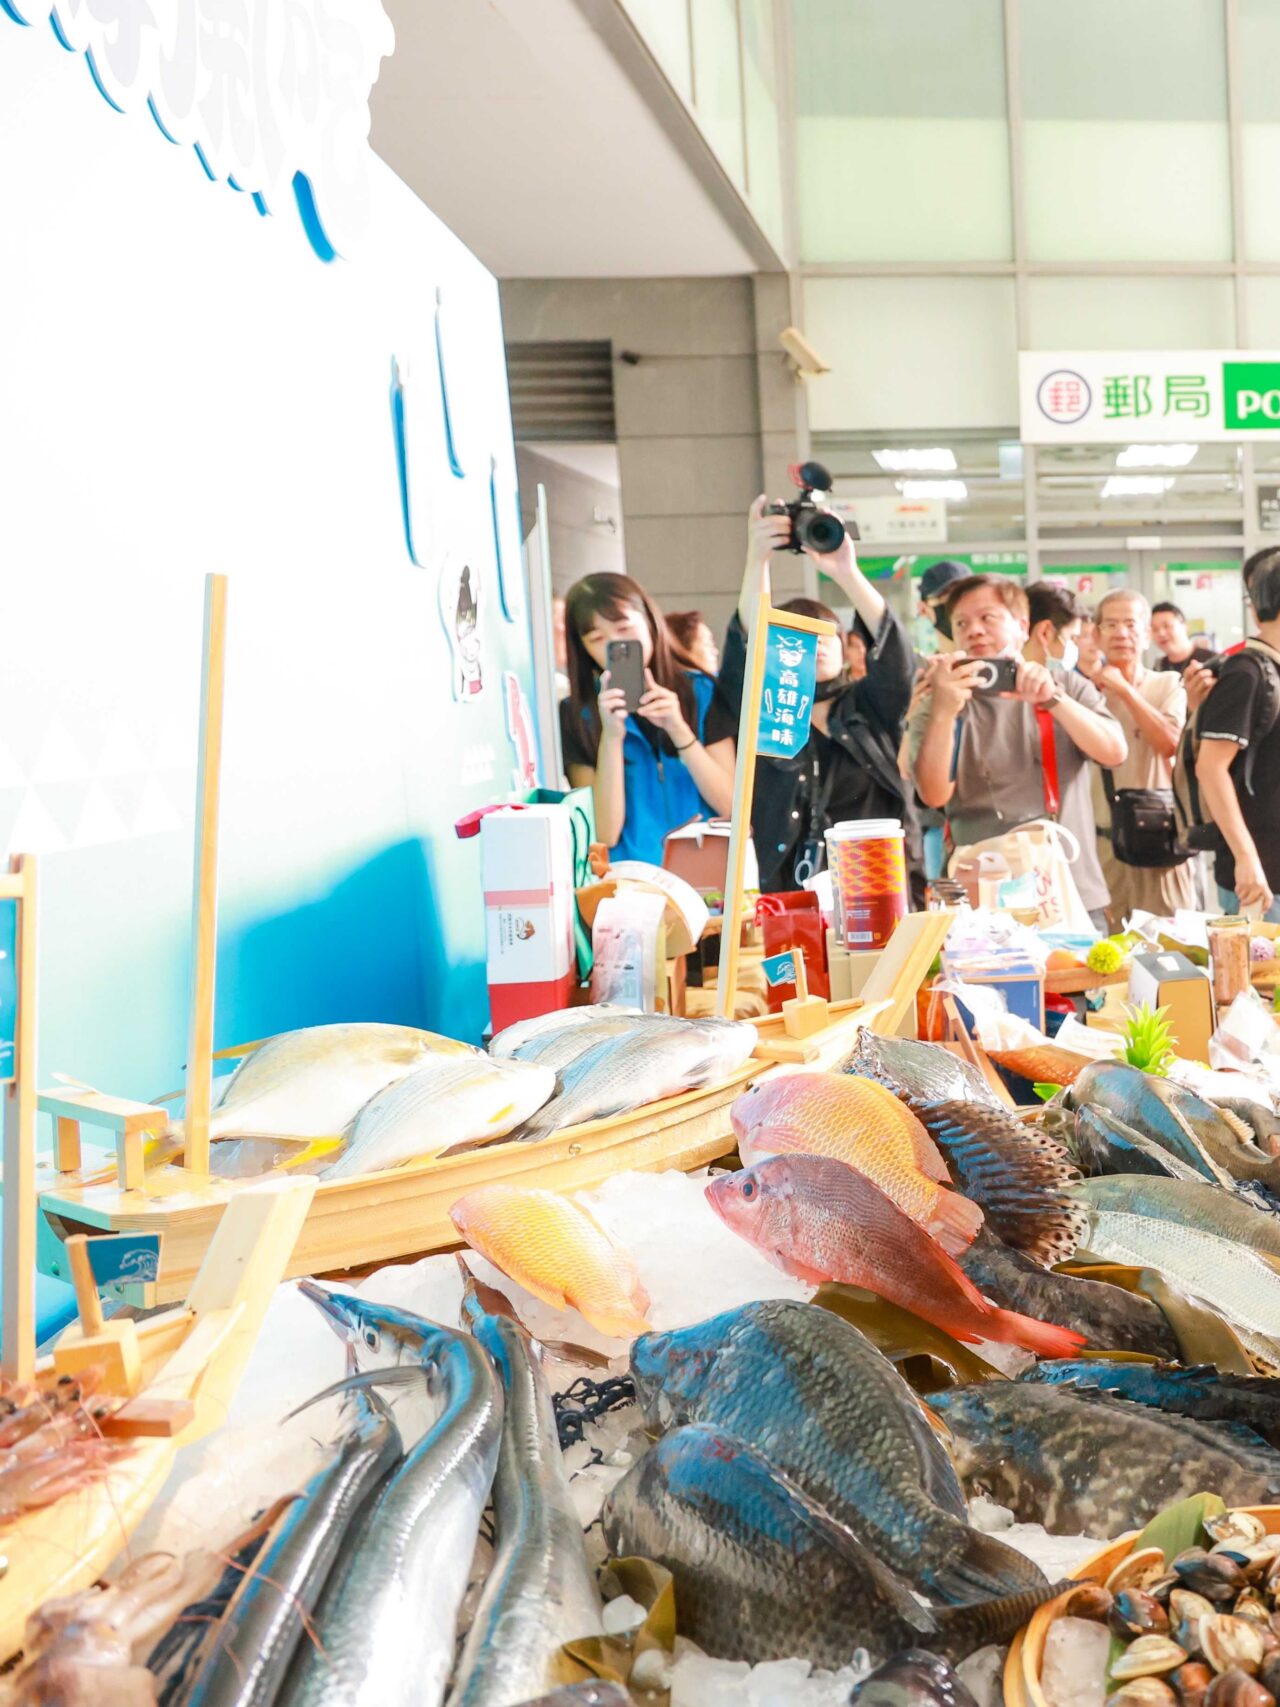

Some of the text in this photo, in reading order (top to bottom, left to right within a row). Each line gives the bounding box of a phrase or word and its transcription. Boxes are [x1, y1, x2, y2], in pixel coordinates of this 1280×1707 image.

[1103, 374, 1211, 419] 郵局
[770, 669, 800, 746] 高雄海味
